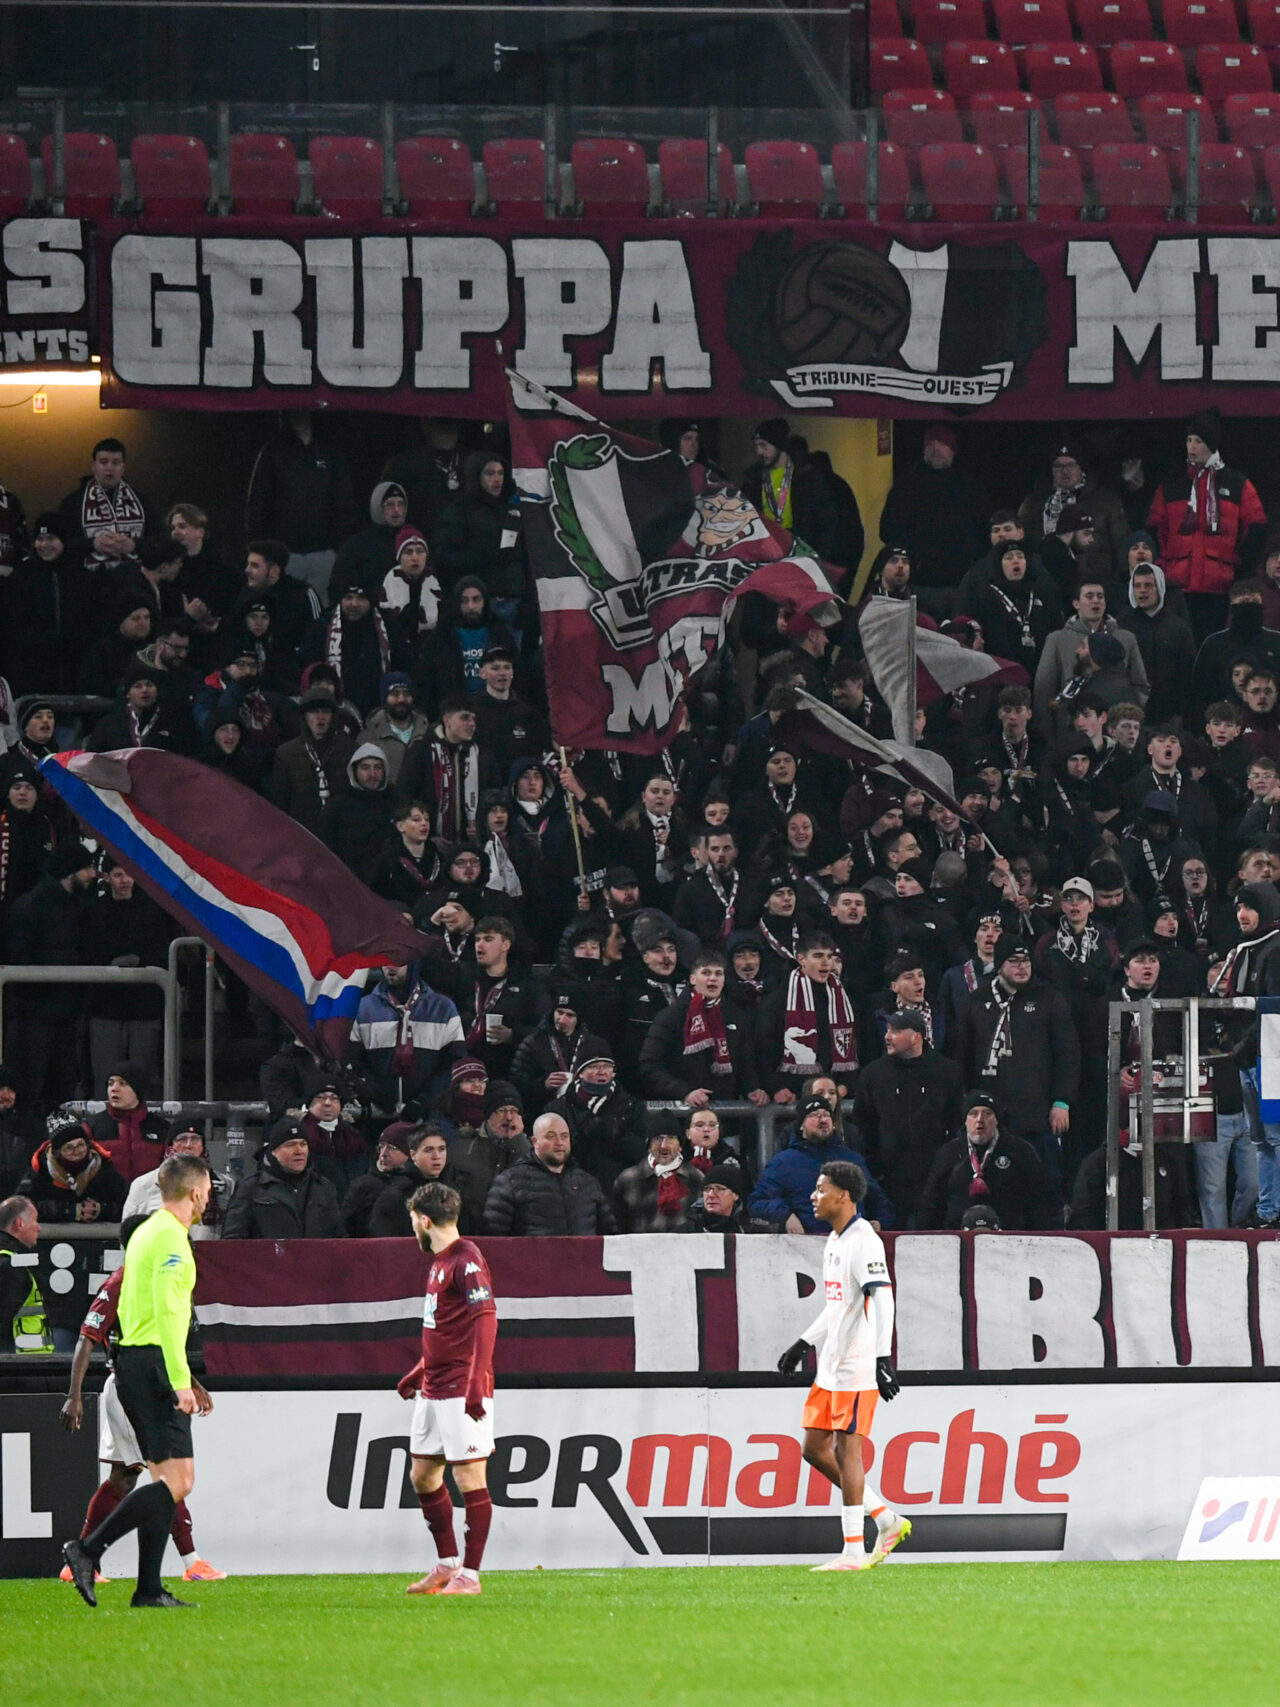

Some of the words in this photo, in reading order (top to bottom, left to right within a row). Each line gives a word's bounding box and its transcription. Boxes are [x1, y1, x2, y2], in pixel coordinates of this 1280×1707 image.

[111, 235, 712, 391] GRUPPA
[0, 328, 89, 363] NTS
[923, 377, 987, 397] OUEST
